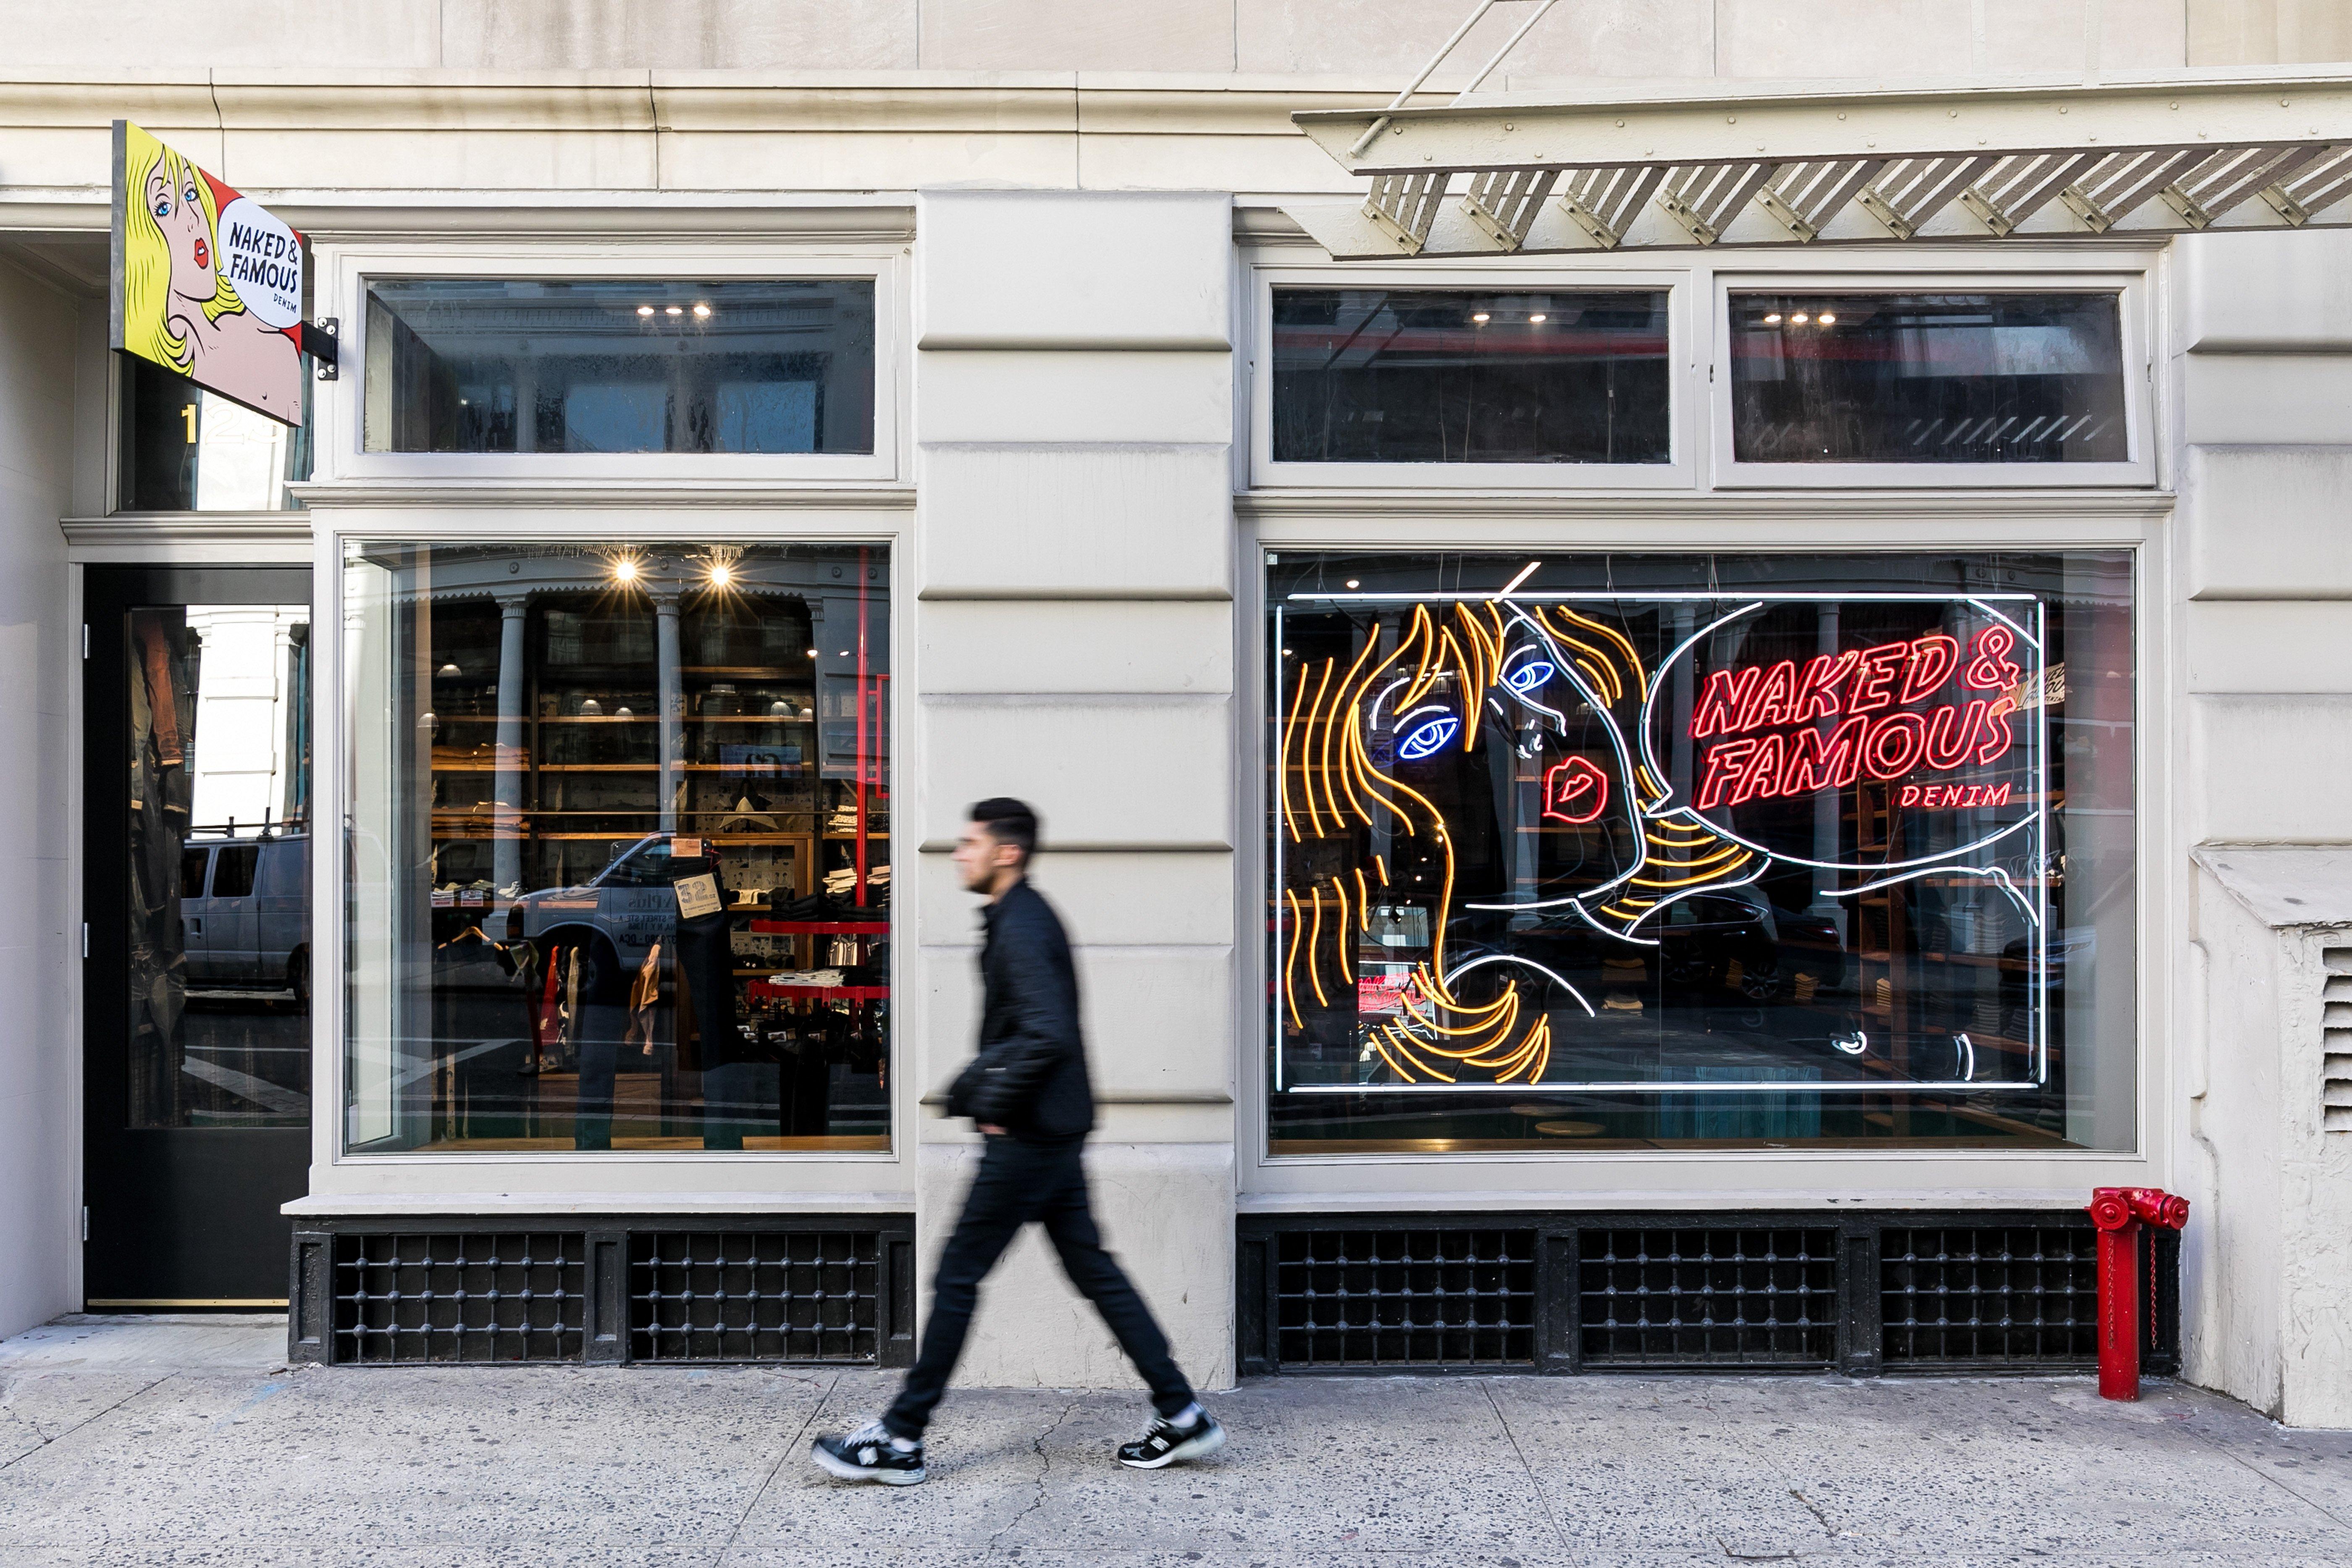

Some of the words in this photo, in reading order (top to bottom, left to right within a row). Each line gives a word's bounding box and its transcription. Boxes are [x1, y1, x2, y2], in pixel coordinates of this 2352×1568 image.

[229, 222, 285, 259] NAKED
[288, 239, 297, 265] &
[230, 254, 297, 294] FAMOUS
[273, 293, 297, 314] DENIM
[1694, 635, 1960, 739] NAKED
[1966, 624, 2020, 692] &
[1698, 695, 2016, 810] FAMOUS
[1900, 782, 2012, 808] DENIM
[677, 881, 709, 903] 32
